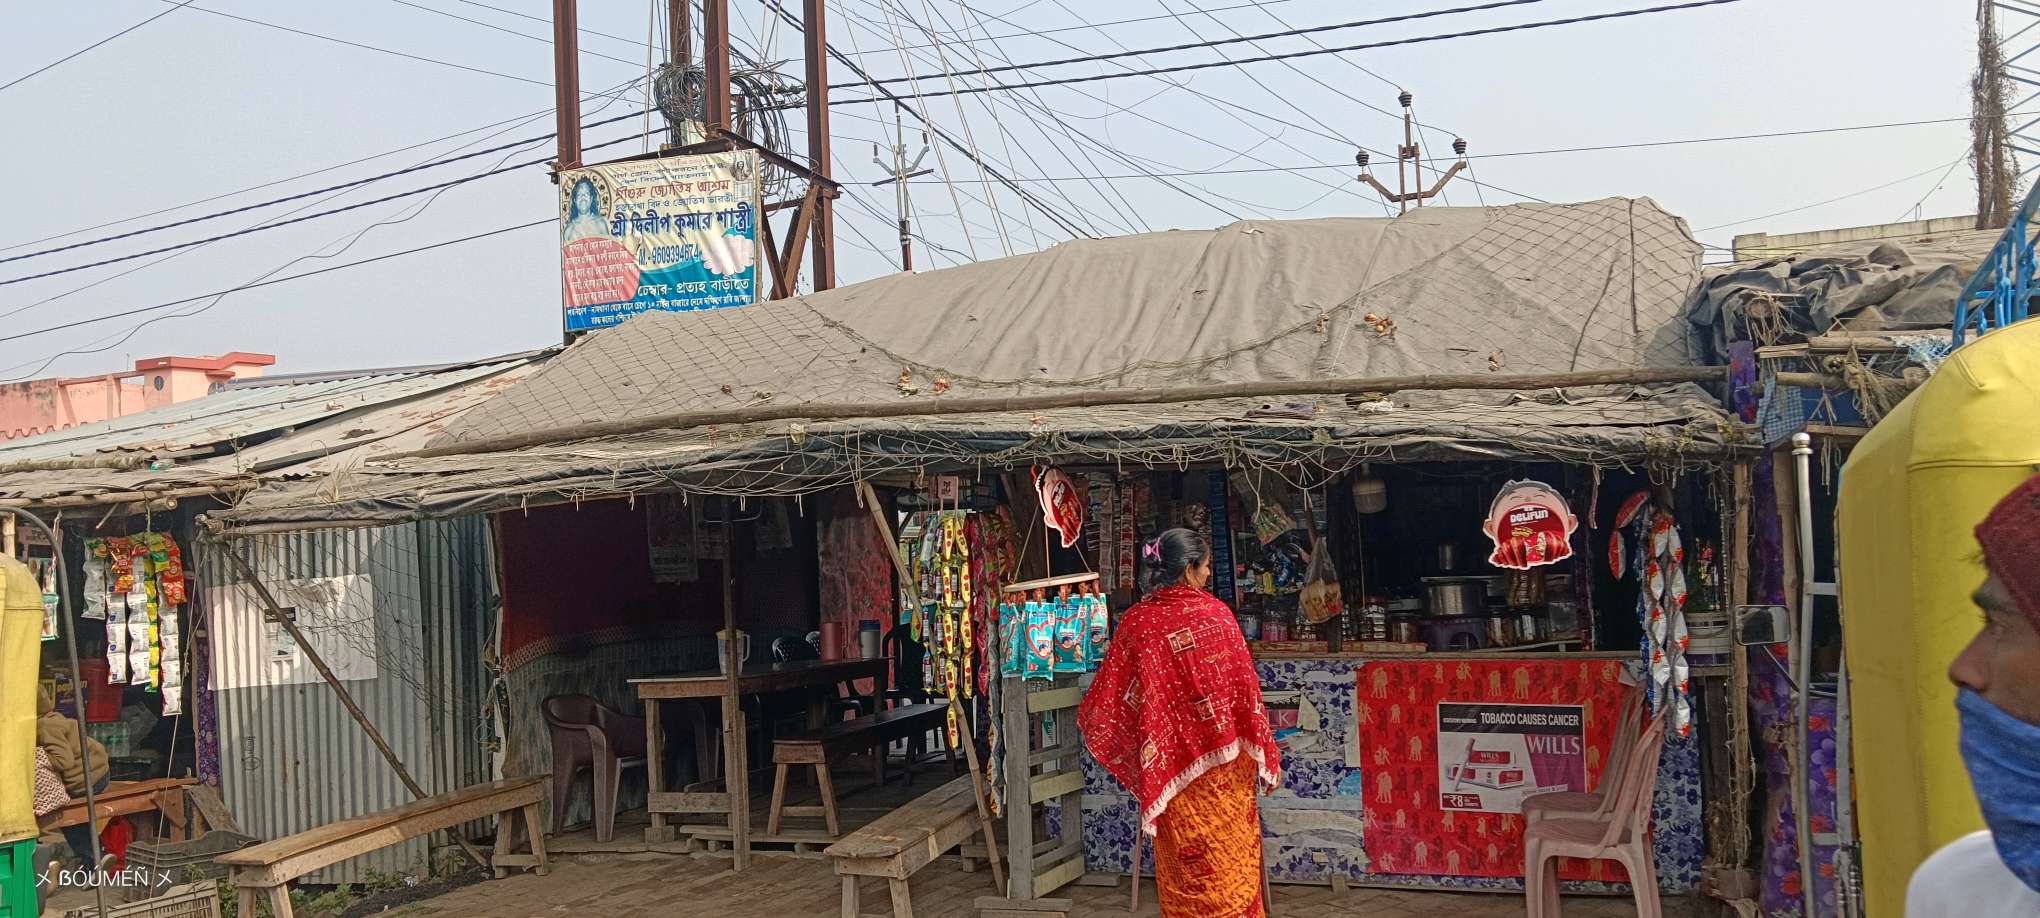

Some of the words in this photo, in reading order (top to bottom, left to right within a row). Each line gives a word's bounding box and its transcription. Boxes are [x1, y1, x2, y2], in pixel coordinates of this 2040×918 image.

[650, 181, 694, 198] জ্যোতিষ
[697, 179, 731, 196] আশ্রম
[610, 208, 628, 238] শ্রী
[631, 208, 671, 236] দিলীপ
[674, 210, 713, 239] কুমার
[716, 201, 752, 233] শাস্ত্রী
[676, 280, 708, 294] প্রত্যহ
[711, 275, 750, 294] বাড়ীতে
[1480, 712, 1516, 725] TOBACCO
[1517, 713, 1547, 725] CAUSES
[1548, 714, 1579, 726] CANCER
[1527, 735, 1580, 755] WILLS
